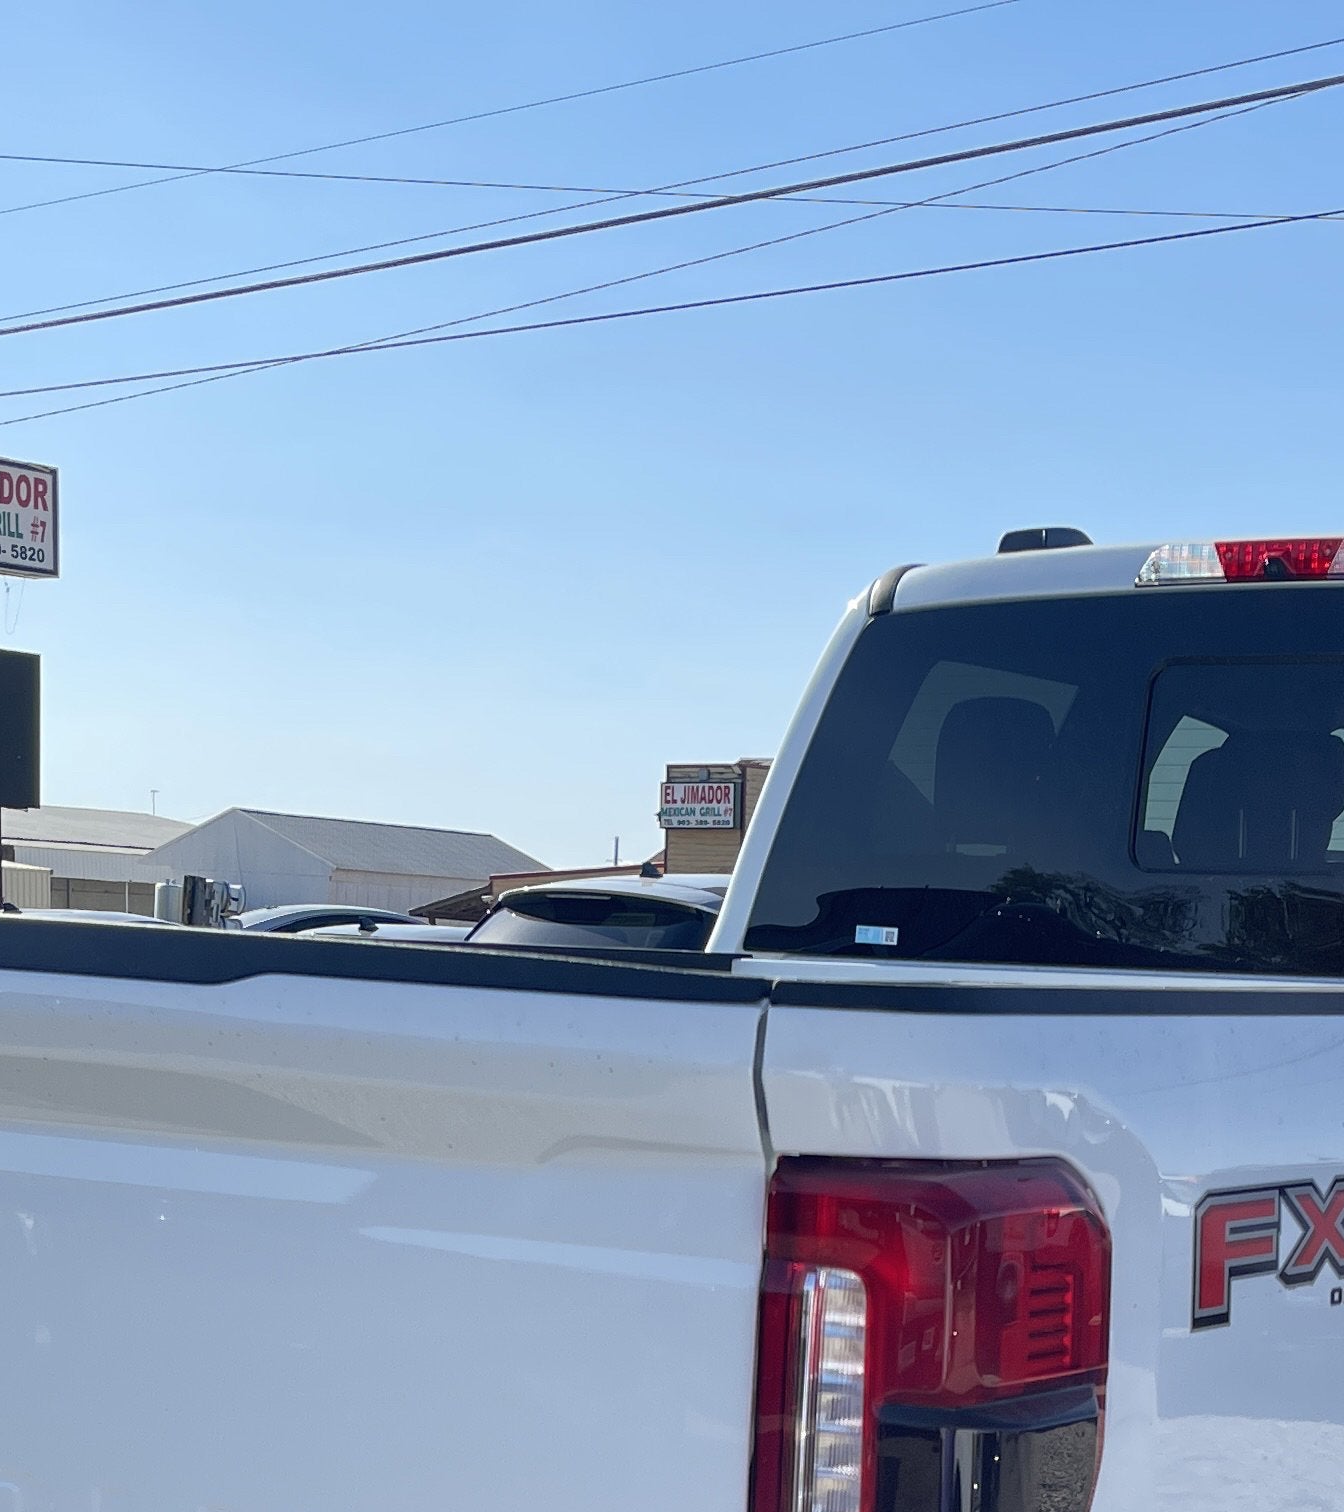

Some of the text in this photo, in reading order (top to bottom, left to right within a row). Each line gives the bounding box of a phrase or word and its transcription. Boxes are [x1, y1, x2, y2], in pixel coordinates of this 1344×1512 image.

[30, 516, 47, 543] #7
[10, 544, 45, 563] 5820
[664, 785, 731, 805] EL JIMADOR
[661, 807, 696, 817] MEXICAN
[699, 807, 722, 817] GRILL
